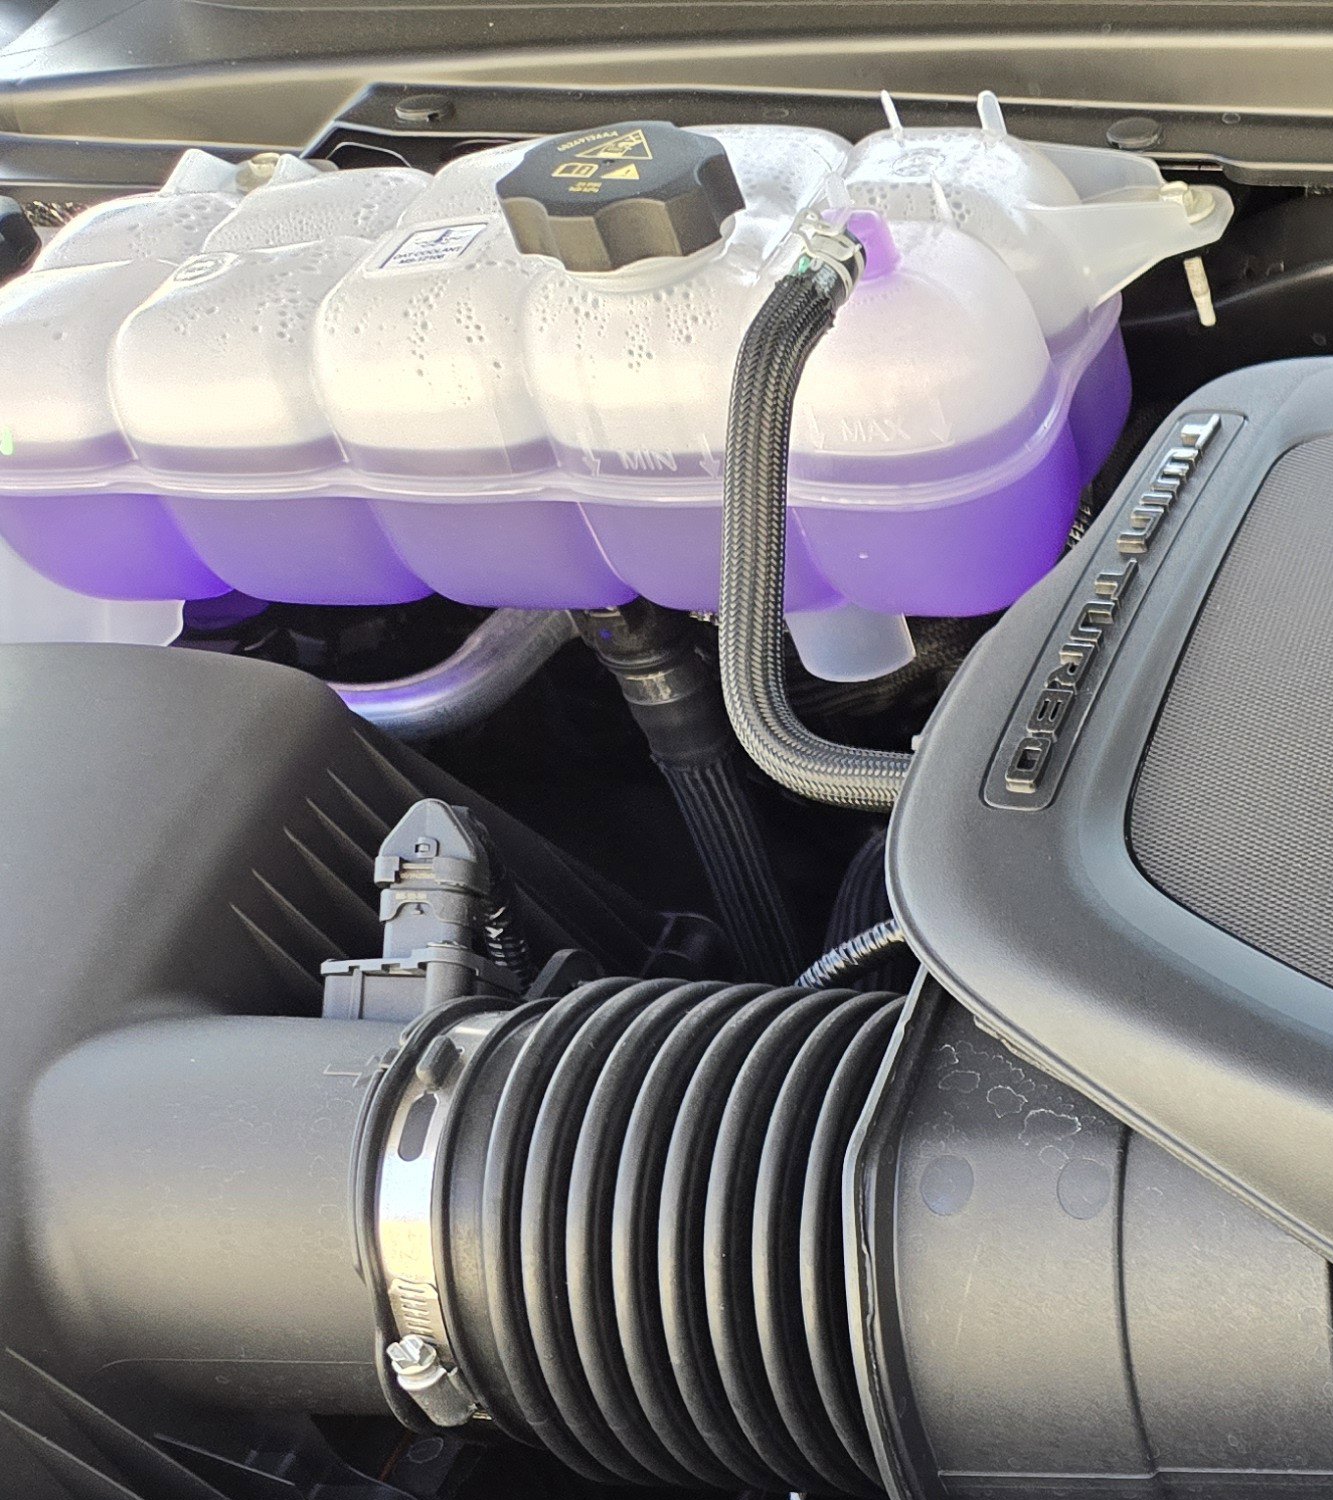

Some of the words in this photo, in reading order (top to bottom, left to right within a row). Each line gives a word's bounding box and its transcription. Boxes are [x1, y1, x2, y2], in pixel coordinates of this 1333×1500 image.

[618, 449, 678, 473] MIN
[840, 418, 912, 443] MAX
[1116, 413, 1222, 555] TWIN
[1005, 558, 1140, 794] TURBO
